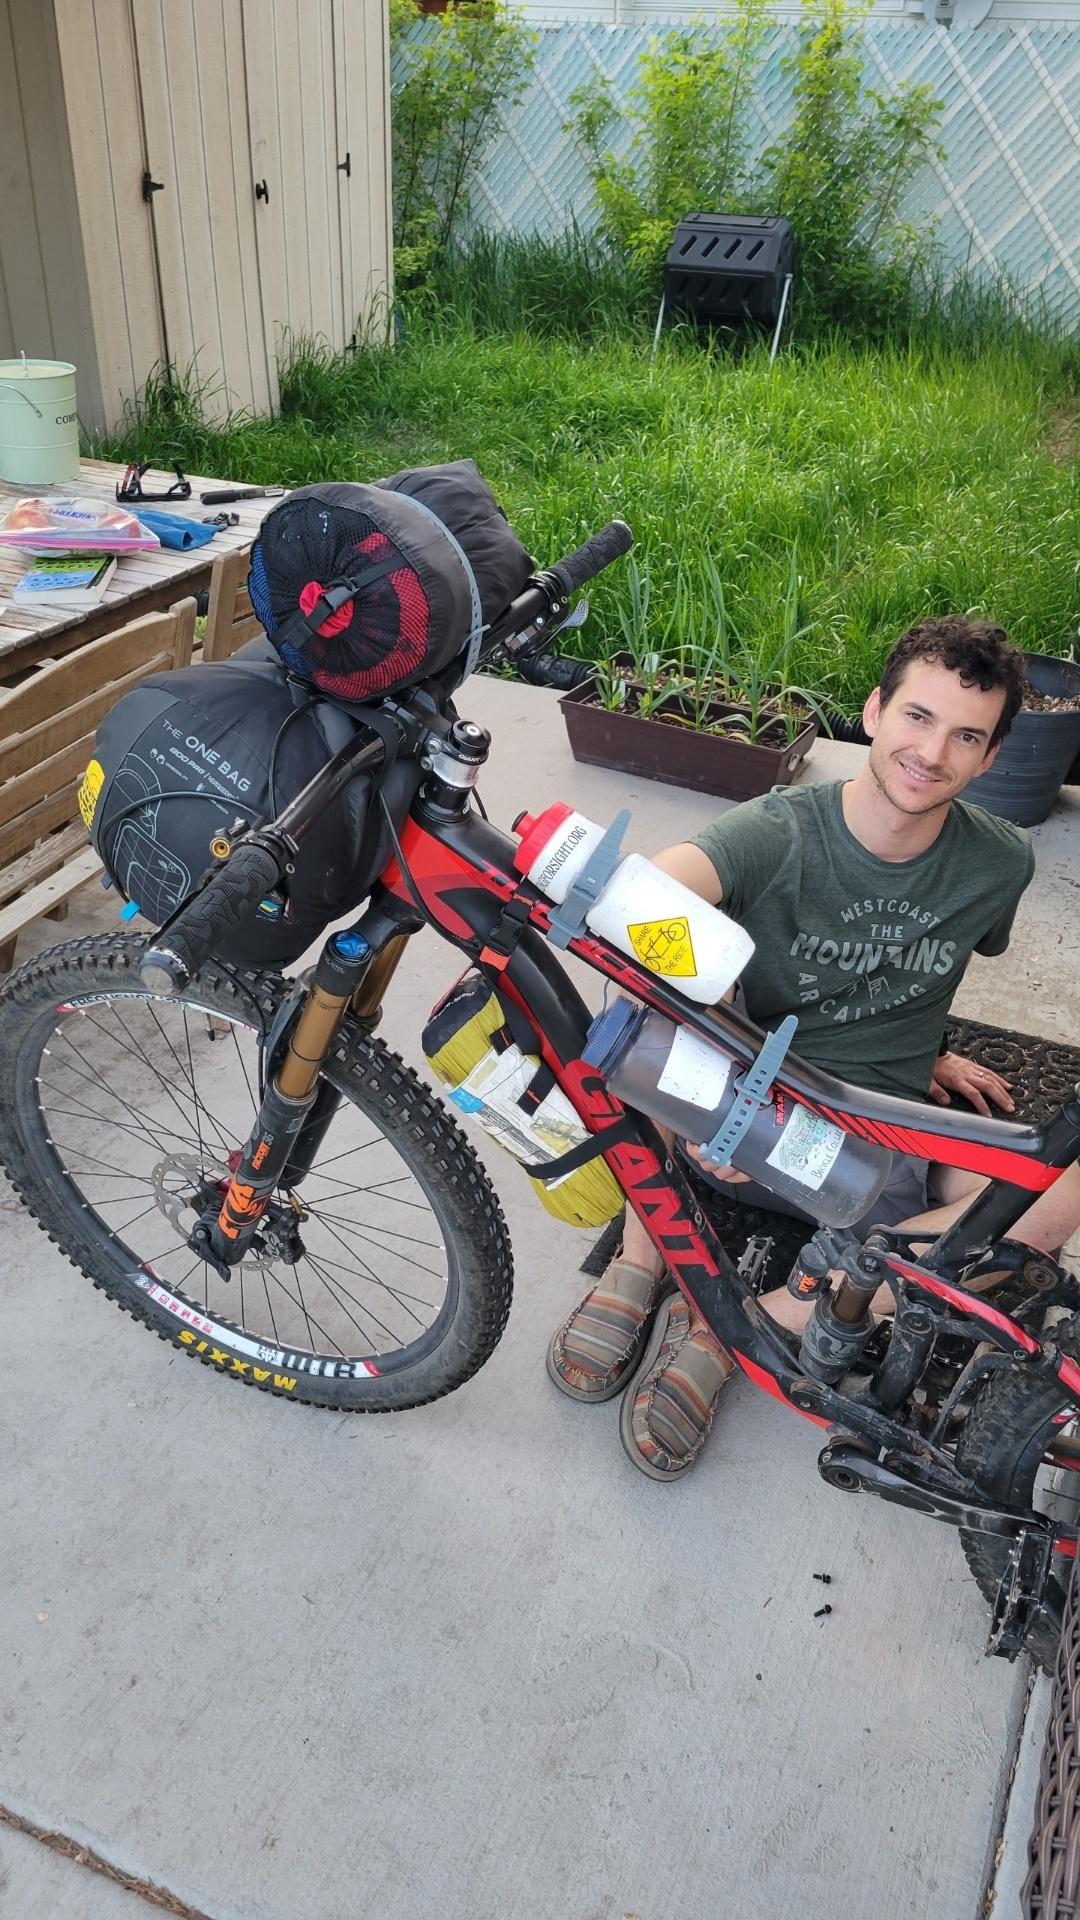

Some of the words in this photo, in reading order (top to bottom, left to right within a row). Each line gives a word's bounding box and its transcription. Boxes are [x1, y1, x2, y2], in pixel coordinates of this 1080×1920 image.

[162, 719, 184, 740] THE
[185, 735, 221, 765] ONE
[217, 760, 252, 792] BAG
[840, 899, 941, 929] WESTCOAST
[634, 925, 652, 945] SHARE
[870, 924, 904, 938] THE
[665, 957, 677, 972] THE
[790, 932, 957, 975] MOUNTAINS
[177, 1330, 298, 1391] MAXXIS
